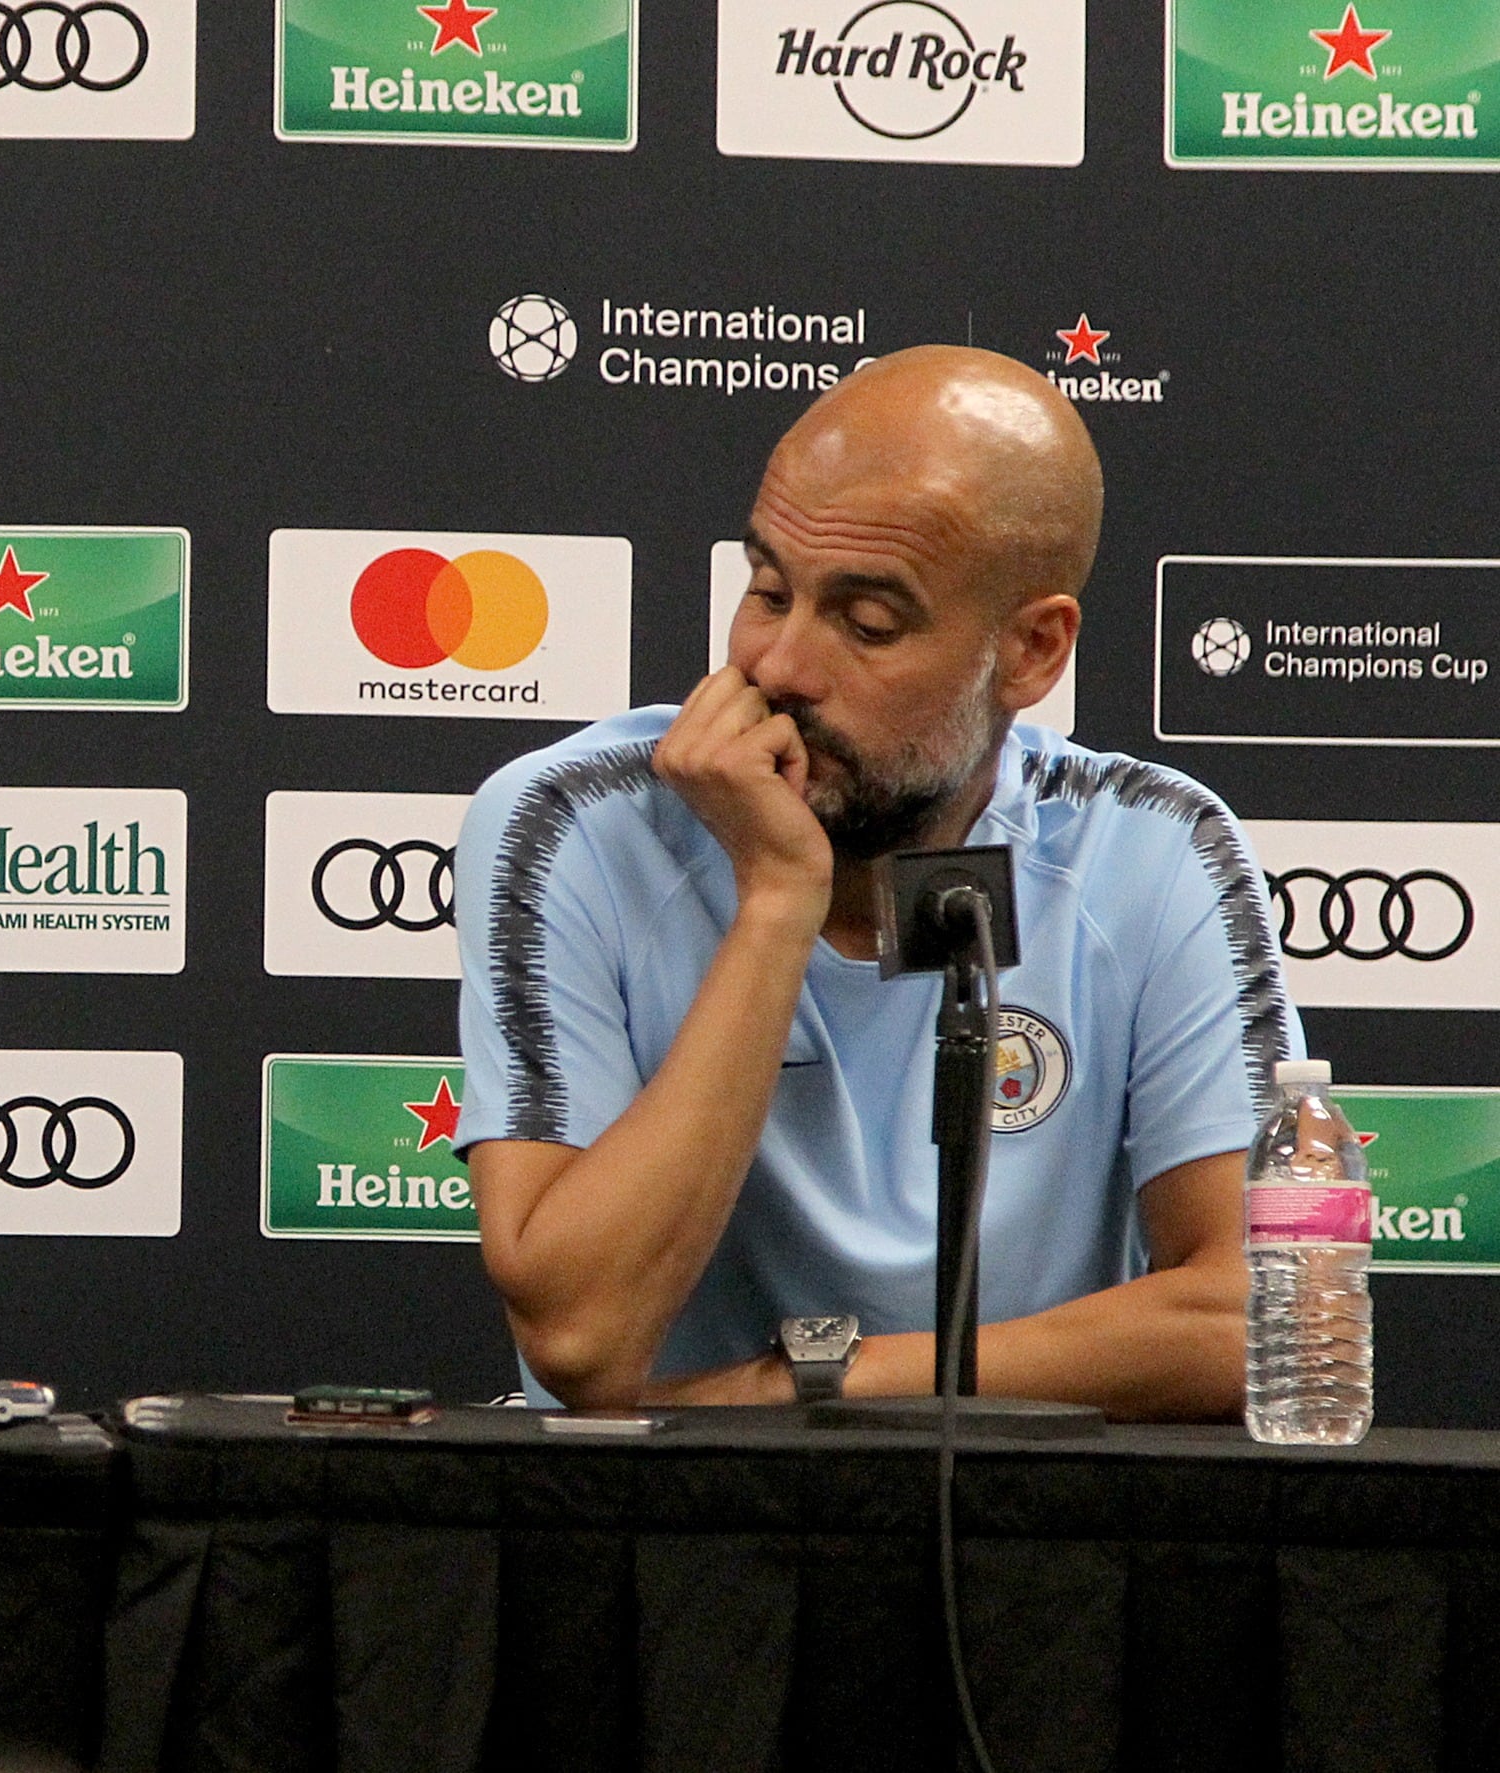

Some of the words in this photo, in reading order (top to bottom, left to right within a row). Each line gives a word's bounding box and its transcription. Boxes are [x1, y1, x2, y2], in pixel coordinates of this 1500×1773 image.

[775, 28, 902, 78] Hard
[909, 35, 1027, 92] Rock
[329, 66, 582, 117] Heineken
[1222, 92, 1478, 139] Heineken
[601, 299, 866, 344] International
[600, 348, 840, 395] Champions
[1265, 620, 1441, 647] International
[359, 678, 539, 704] mastercard
[1264, 653, 1424, 684] Champions
[1431, 654, 1489, 684] Cup
[33, 913, 97, 931] HEALTH
[103, 914, 170, 931] SYSTEM
[1003, 1104, 1039, 1126] CITY
[316, 1164, 475, 1210] Heine
[1370, 1197, 1466, 1242] ken
